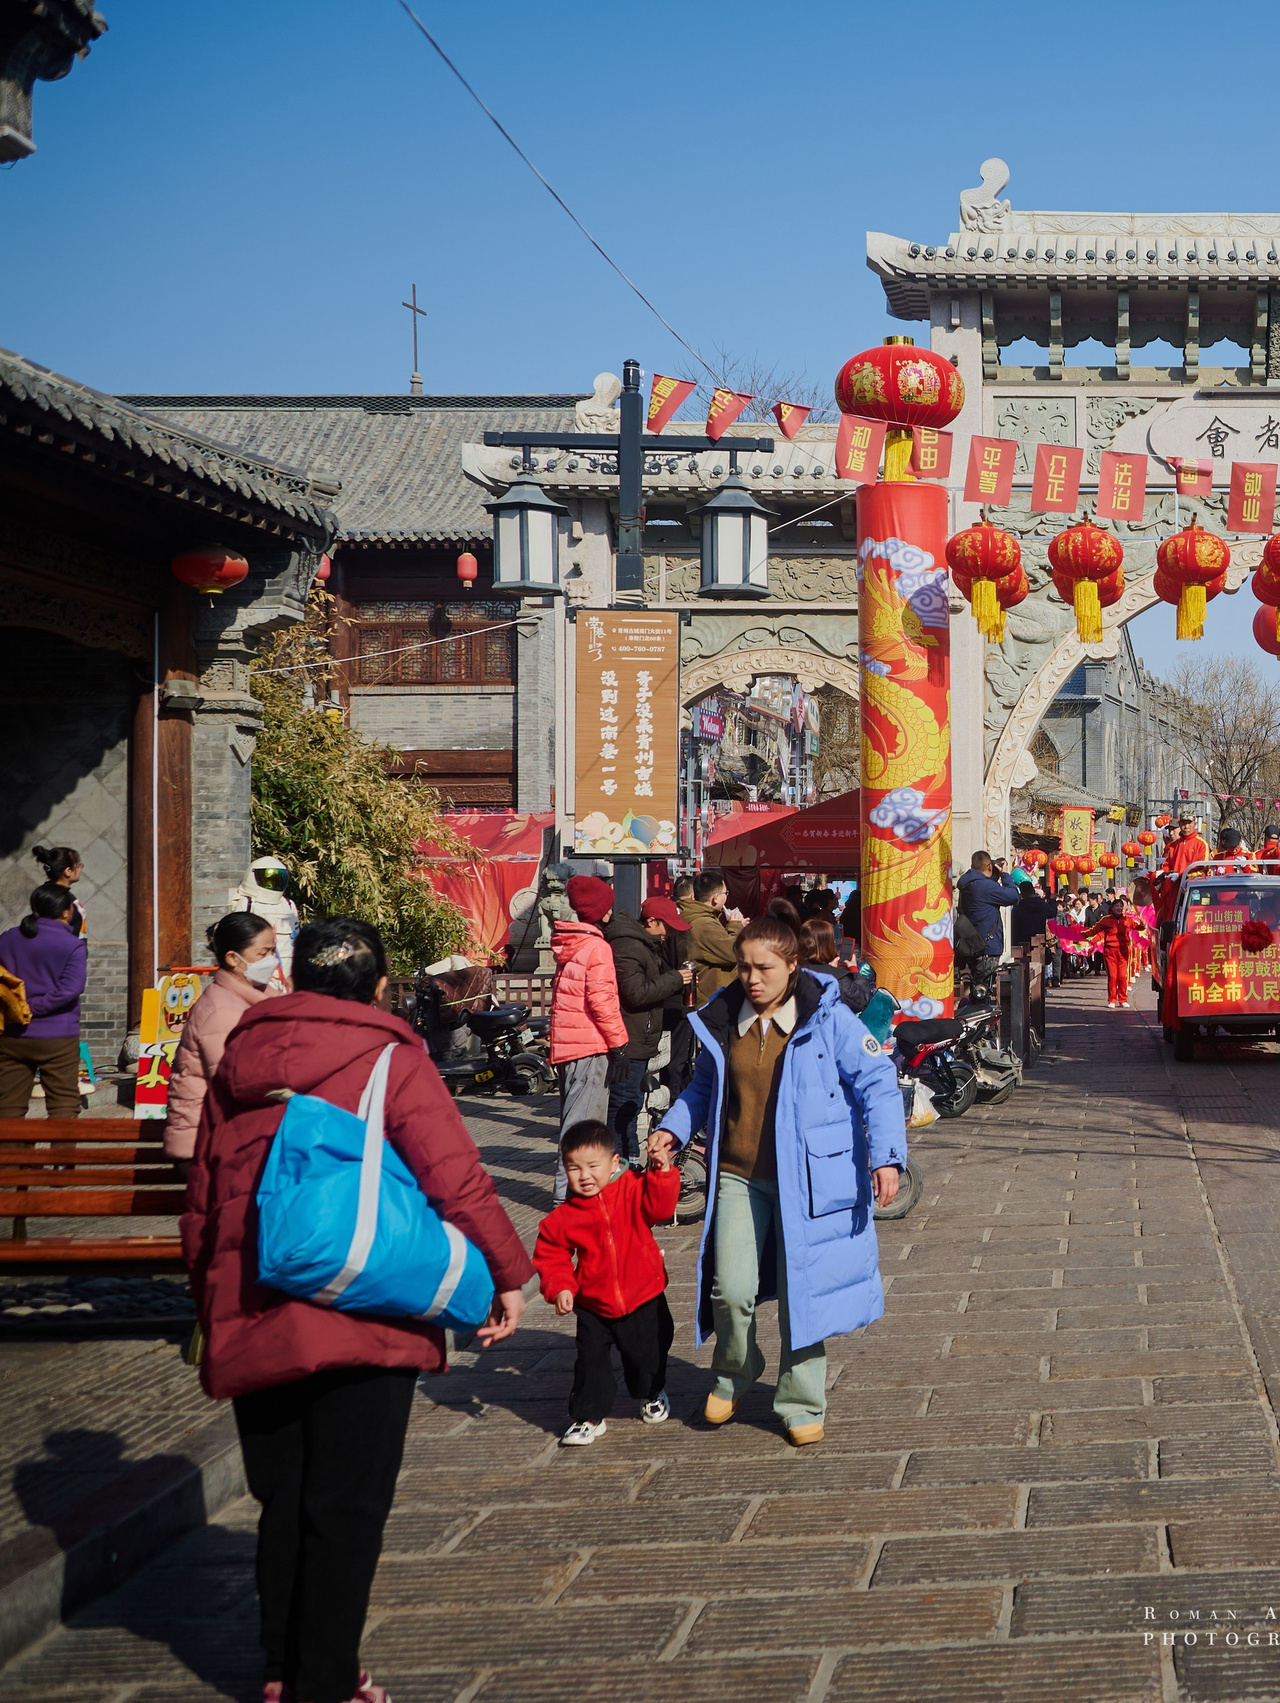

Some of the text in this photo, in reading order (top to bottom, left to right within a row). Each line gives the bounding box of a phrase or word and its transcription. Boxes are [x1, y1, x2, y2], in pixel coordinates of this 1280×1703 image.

[845, 425, 872, 472] 和谐
[920, 426, 938, 470] 自由
[979, 446, 1002, 494] 平等
[1045, 454, 1067, 503] 公正
[1111, 462, 1133, 511] 法治
[1241, 472, 1262, 523] 敬业
[599, 670, 619, 796] 没到过南巷一号
[1194, 910, 1243, 923] 云门山街道
